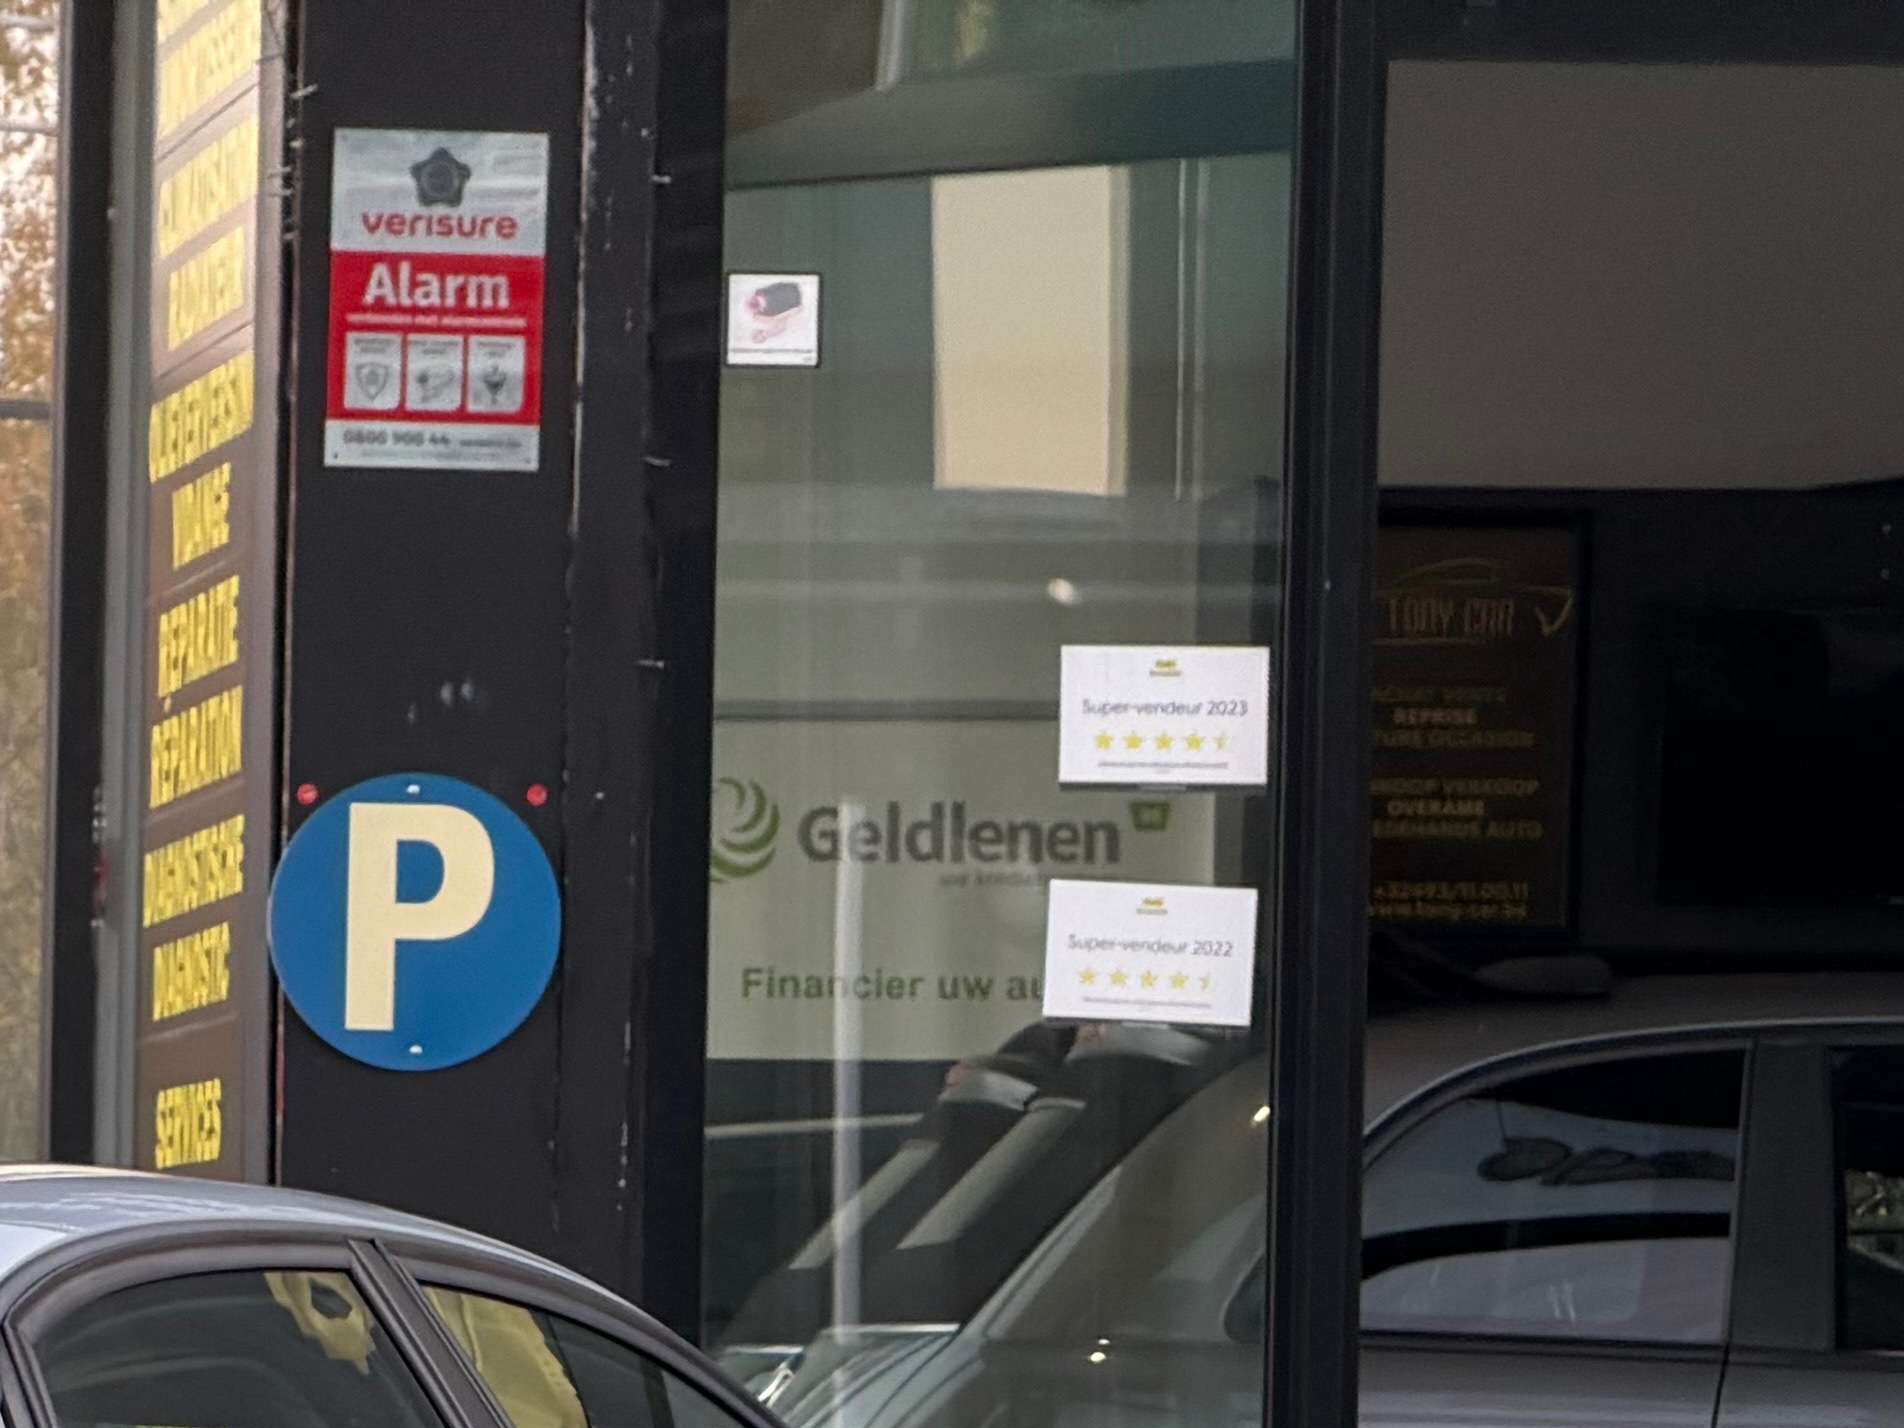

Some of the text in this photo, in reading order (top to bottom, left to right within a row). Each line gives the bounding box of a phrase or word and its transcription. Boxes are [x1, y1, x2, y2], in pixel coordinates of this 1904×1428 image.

[361, 211, 518, 240] verisure
[363, 262, 510, 309] Alarm
[1081, 698, 1249, 718] Super-vendeur 2023
[798, 801, 1121, 865] Geldlenen
[345, 802, 496, 1031] P
[1191, 939, 1234, 958] 2022
[742, 967, 924, 1001] Financier
[937, 974, 992, 1001] uw
[154, 1077, 221, 1170] SERVICES
